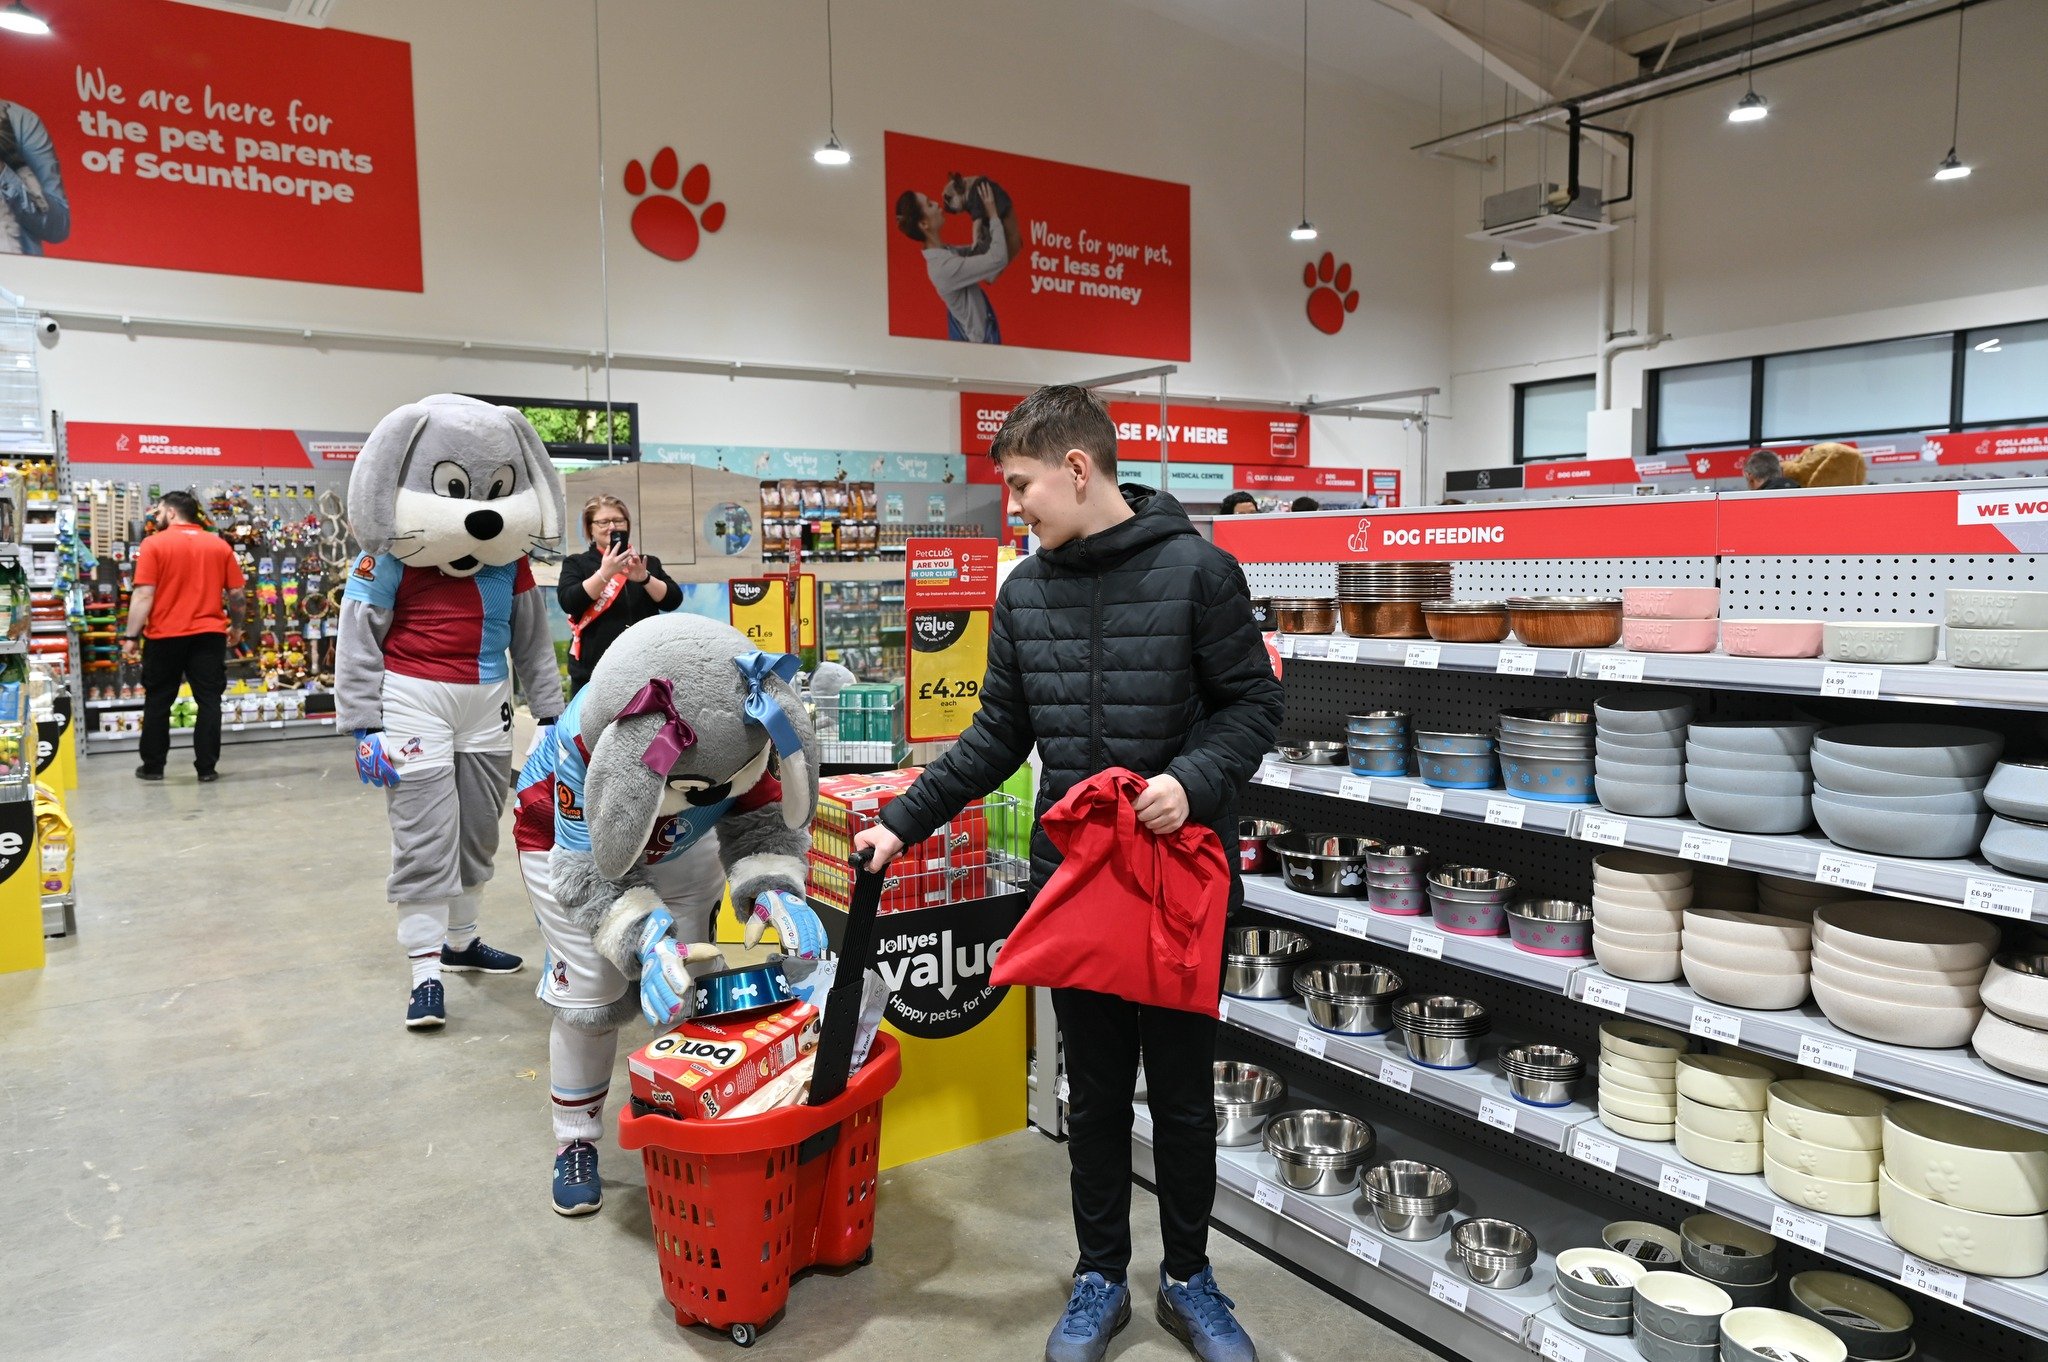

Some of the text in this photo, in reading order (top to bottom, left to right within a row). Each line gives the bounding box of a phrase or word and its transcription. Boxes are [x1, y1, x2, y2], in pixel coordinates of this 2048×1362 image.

[76, 64, 333, 135] We are here for
[77, 110, 373, 174] the pet parents
[81, 147, 354, 205] of Scunthorpe
[1030, 219, 1172, 266] More for your pet,
[1030, 251, 1124, 280] for less of
[1030, 274, 1142, 306] your money
[138, 435, 169, 445] BIRD
[1112, 422, 1228, 445] ASE PAY HERE
[138, 444, 222, 456] ACCESSORIES
[783, 452, 817, 468] Spring
[896, 455, 928, 471] Spring
[1977, 504, 2010, 517] WE
[1383, 526, 1504, 546] DOG FEEDING
[734, 584, 761, 596] value
[1972, 594, 2017, 607] FIRST
[1950, 607, 2015, 626] BOWL
[747, 625, 773, 638] £1.69
[915, 617, 955, 634] value
[1865, 631, 1905, 643] FIRST
[1975, 633, 2021, 647] FIRST
[1839, 643, 1904, 660] BOWL
[1954, 647, 2020, 665] BOWL
[919, 678, 978, 700] £4.29
[500, 701, 512, 732] 9
[1822, 864, 1841, 873] £8.49
[1971, 889, 1992, 899] £6.99
[876, 932, 938, 955] Jollyes
[1588, 986, 1602, 994] £4.49
[889, 994, 928, 1023] Happy
[929, 1008, 961, 1024] pets,
[962, 996, 980, 1013] for
[1695, 1015, 1711, 1024] £6.49
[1802, 1044, 1820, 1054] £8.99
[1481, 1106, 1494, 1115] £2.79
[1577, 1141, 1591, 1150] £3.99
[1664, 1174, 1679, 1184] £4.79
[1776, 1216, 1793, 1227] £6.79
[1905, 1264, 1925, 1277] £9.79
[1432, 1280, 1444, 1291] £2.79
